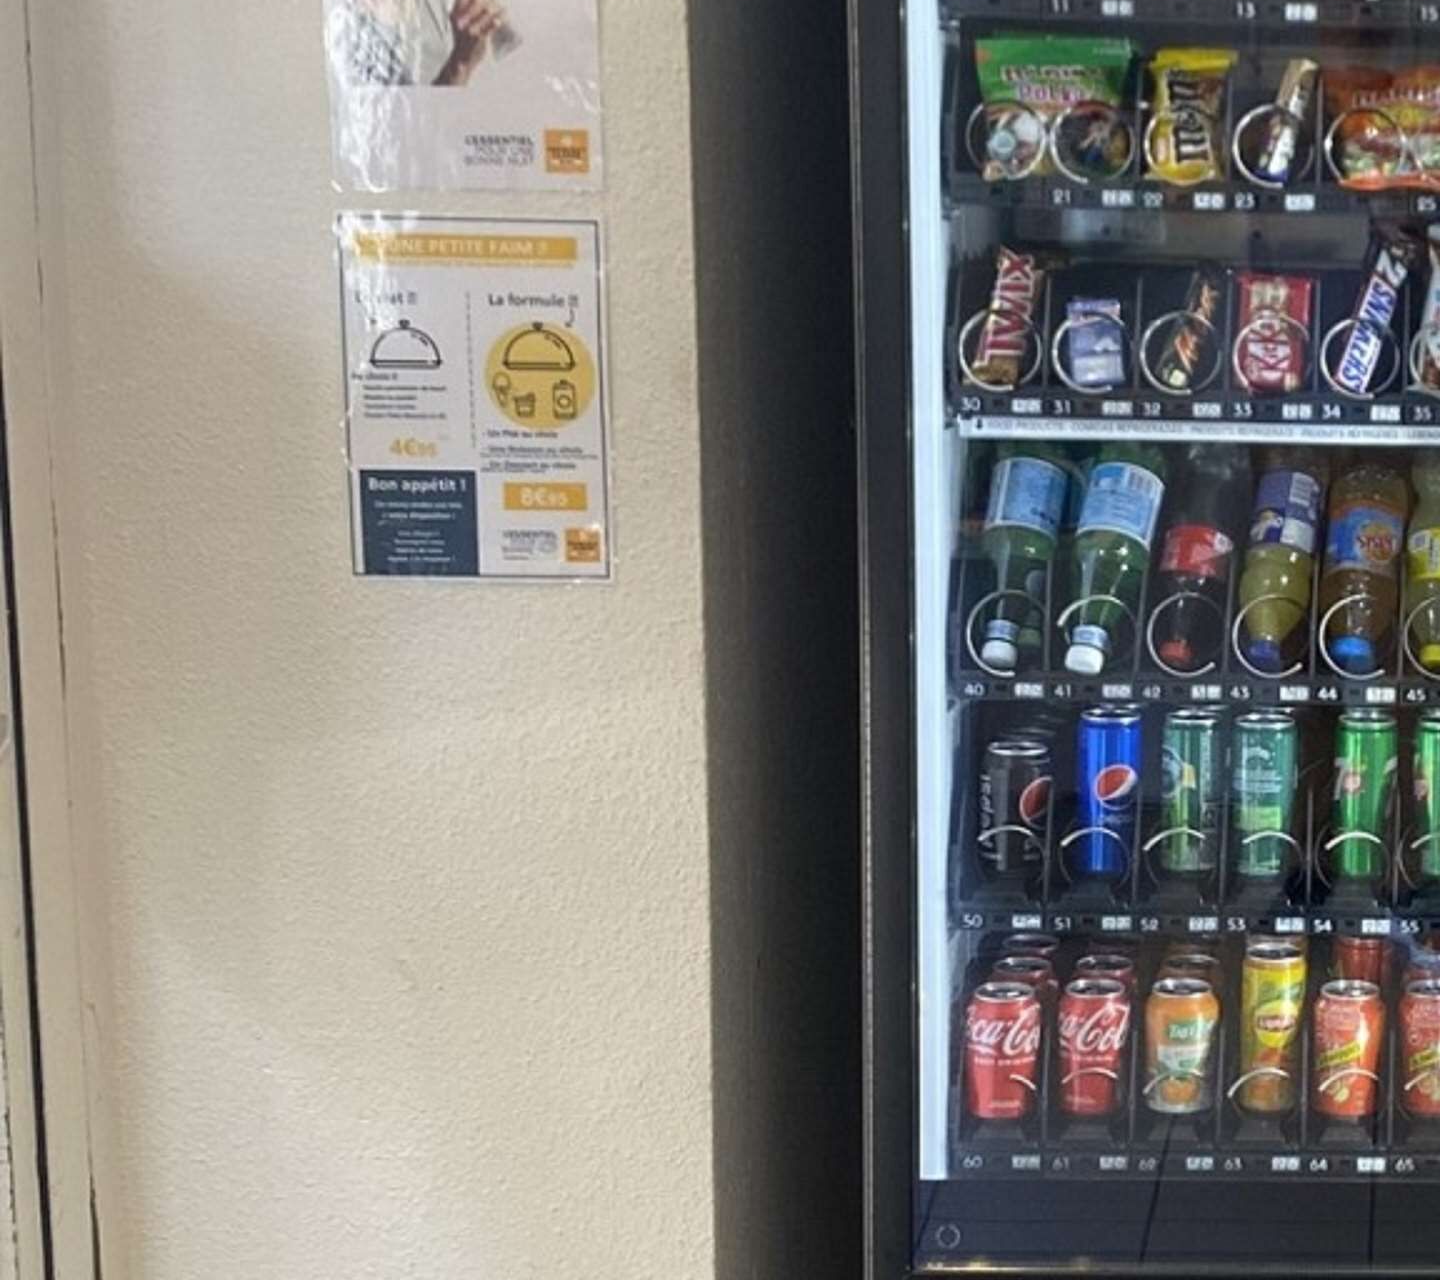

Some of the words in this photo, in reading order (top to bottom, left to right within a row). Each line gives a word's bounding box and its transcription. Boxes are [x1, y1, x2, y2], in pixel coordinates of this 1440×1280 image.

[430, 239, 481, 255] PETITE
[489, 240, 533, 256] FAIM
[488, 293, 504, 307] La
[507, 293, 566, 308] formule
[986, 245, 1034, 357] TWIX
[368, 477, 397, 491] Bon
[401, 477, 456, 494] appétit
